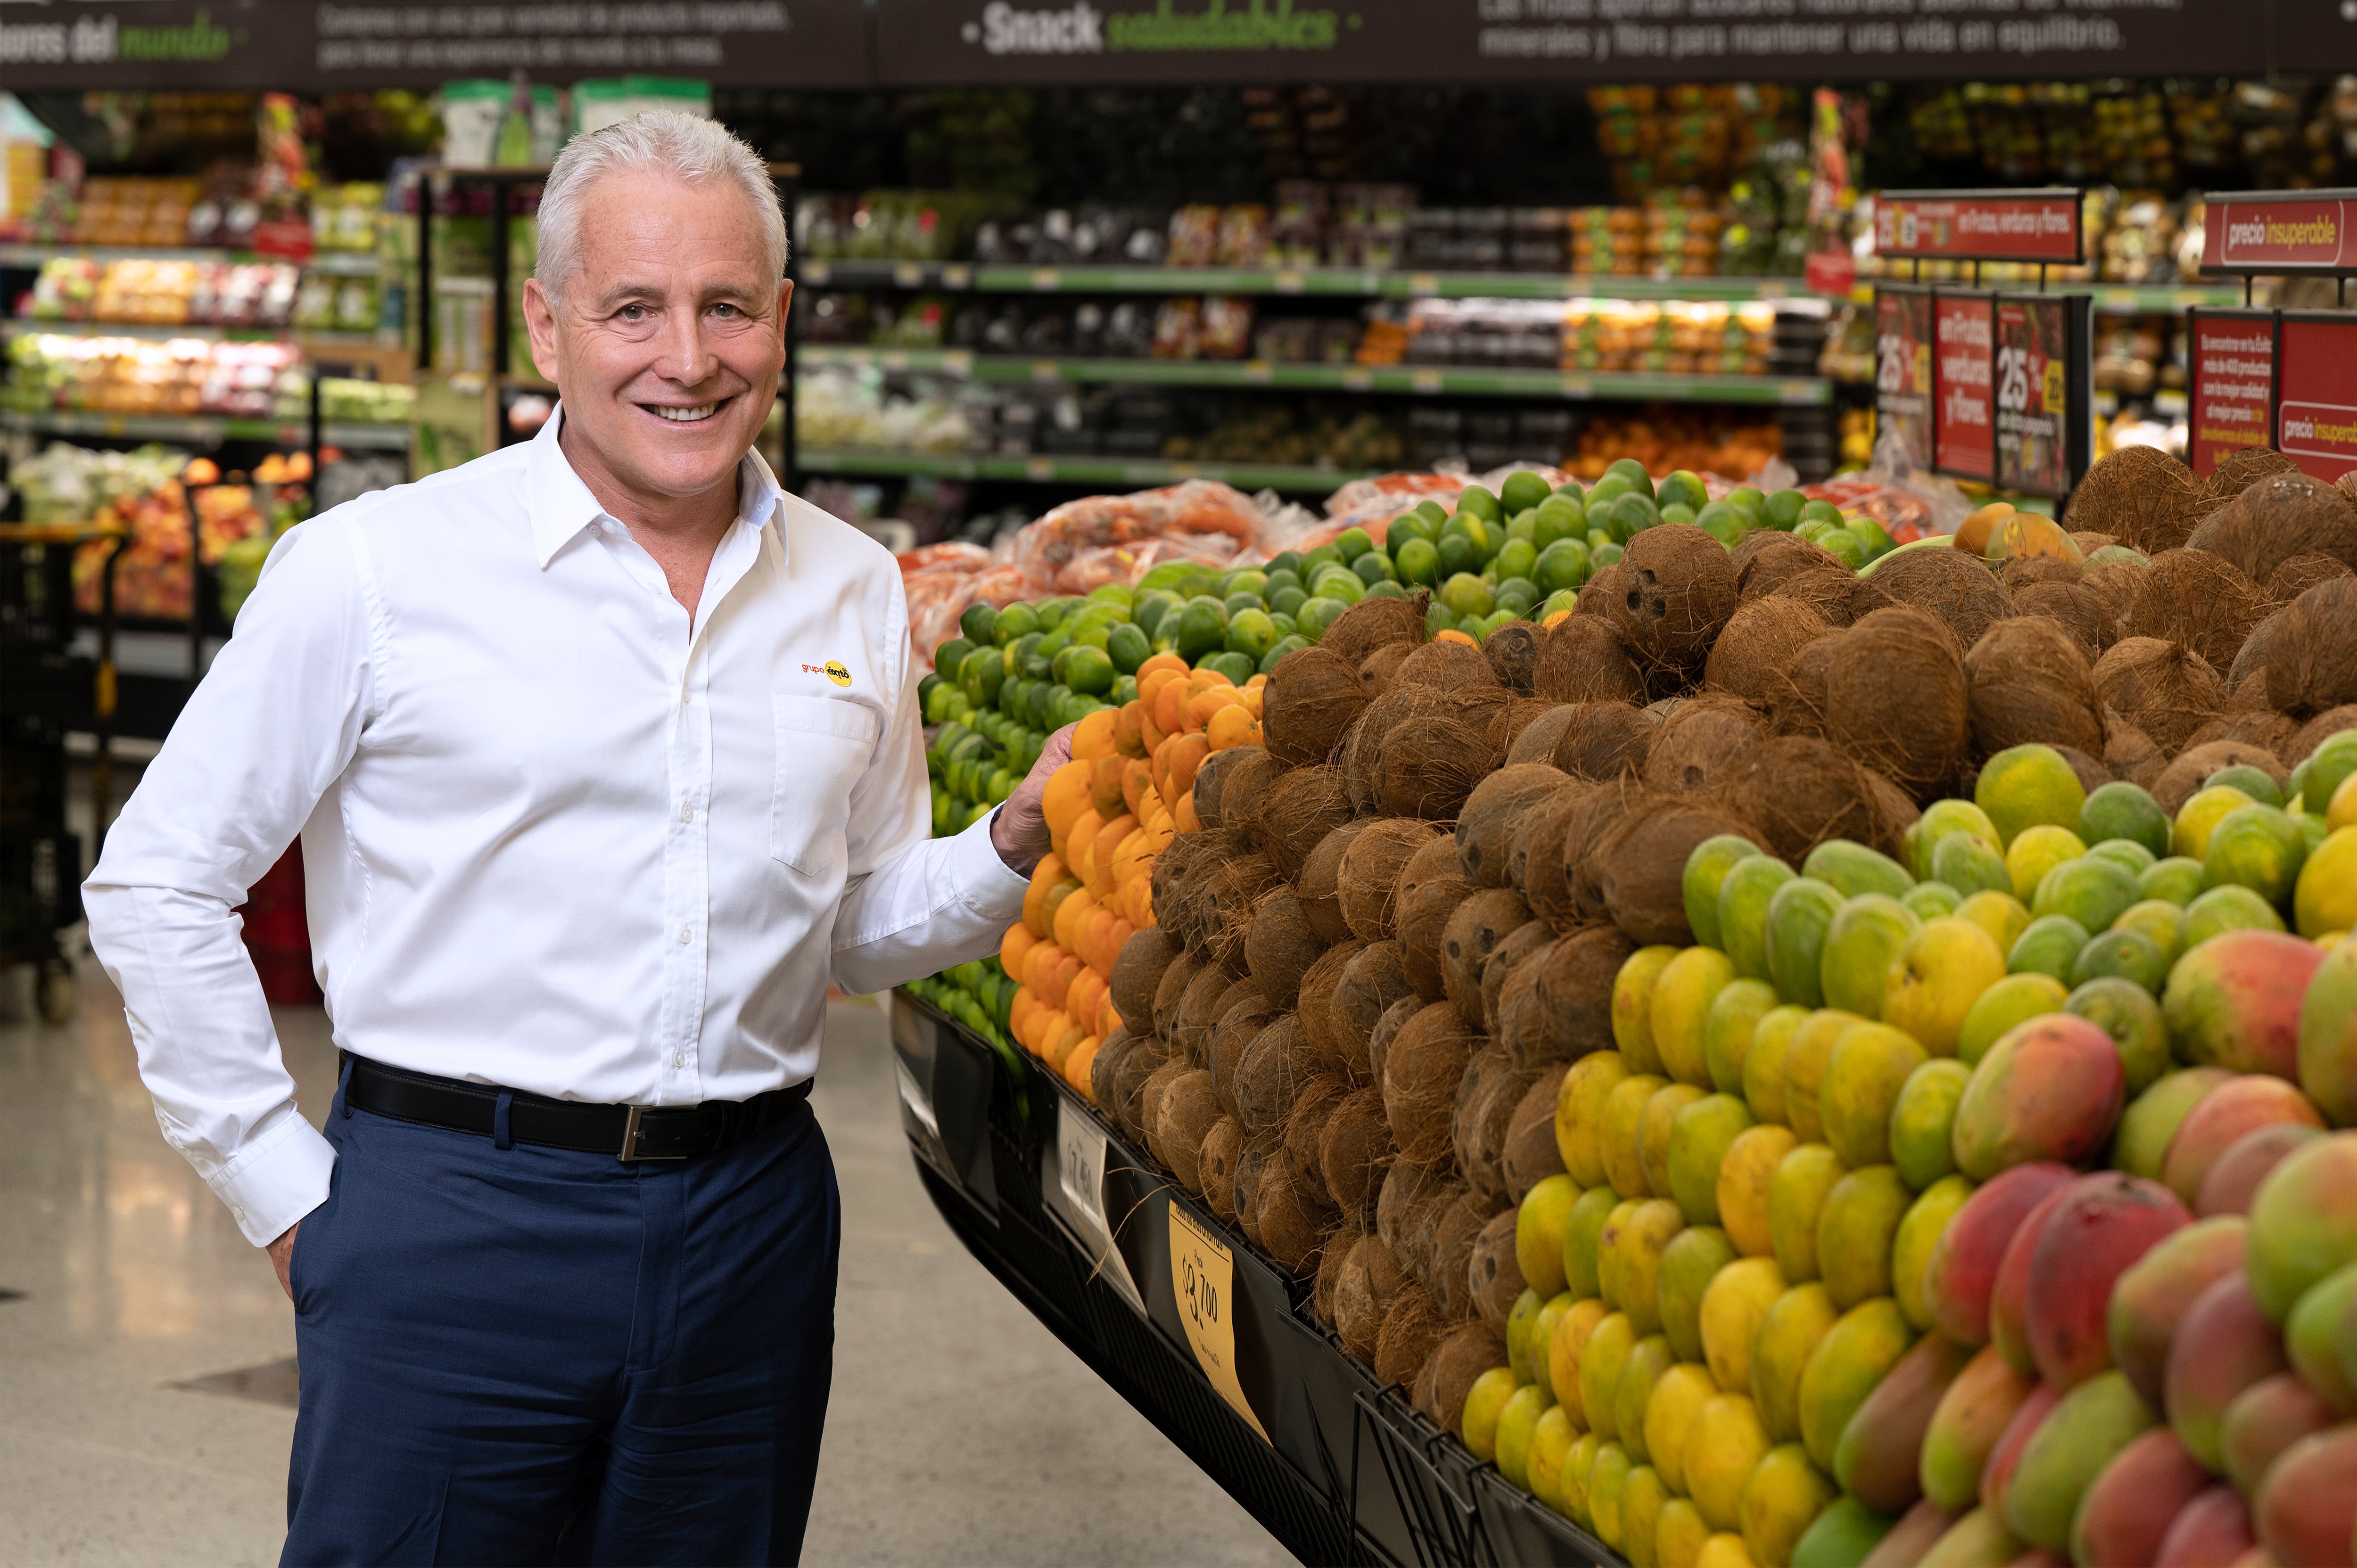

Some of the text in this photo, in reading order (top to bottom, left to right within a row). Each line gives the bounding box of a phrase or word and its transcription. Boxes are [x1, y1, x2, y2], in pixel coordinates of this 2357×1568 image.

[984, 0, 1336, 52] Snack saludables
[2228, 214, 2335, 251] precio insuperable
[2284, 415, 2313, 442] precio
[802, 664, 825, 674] grupo
